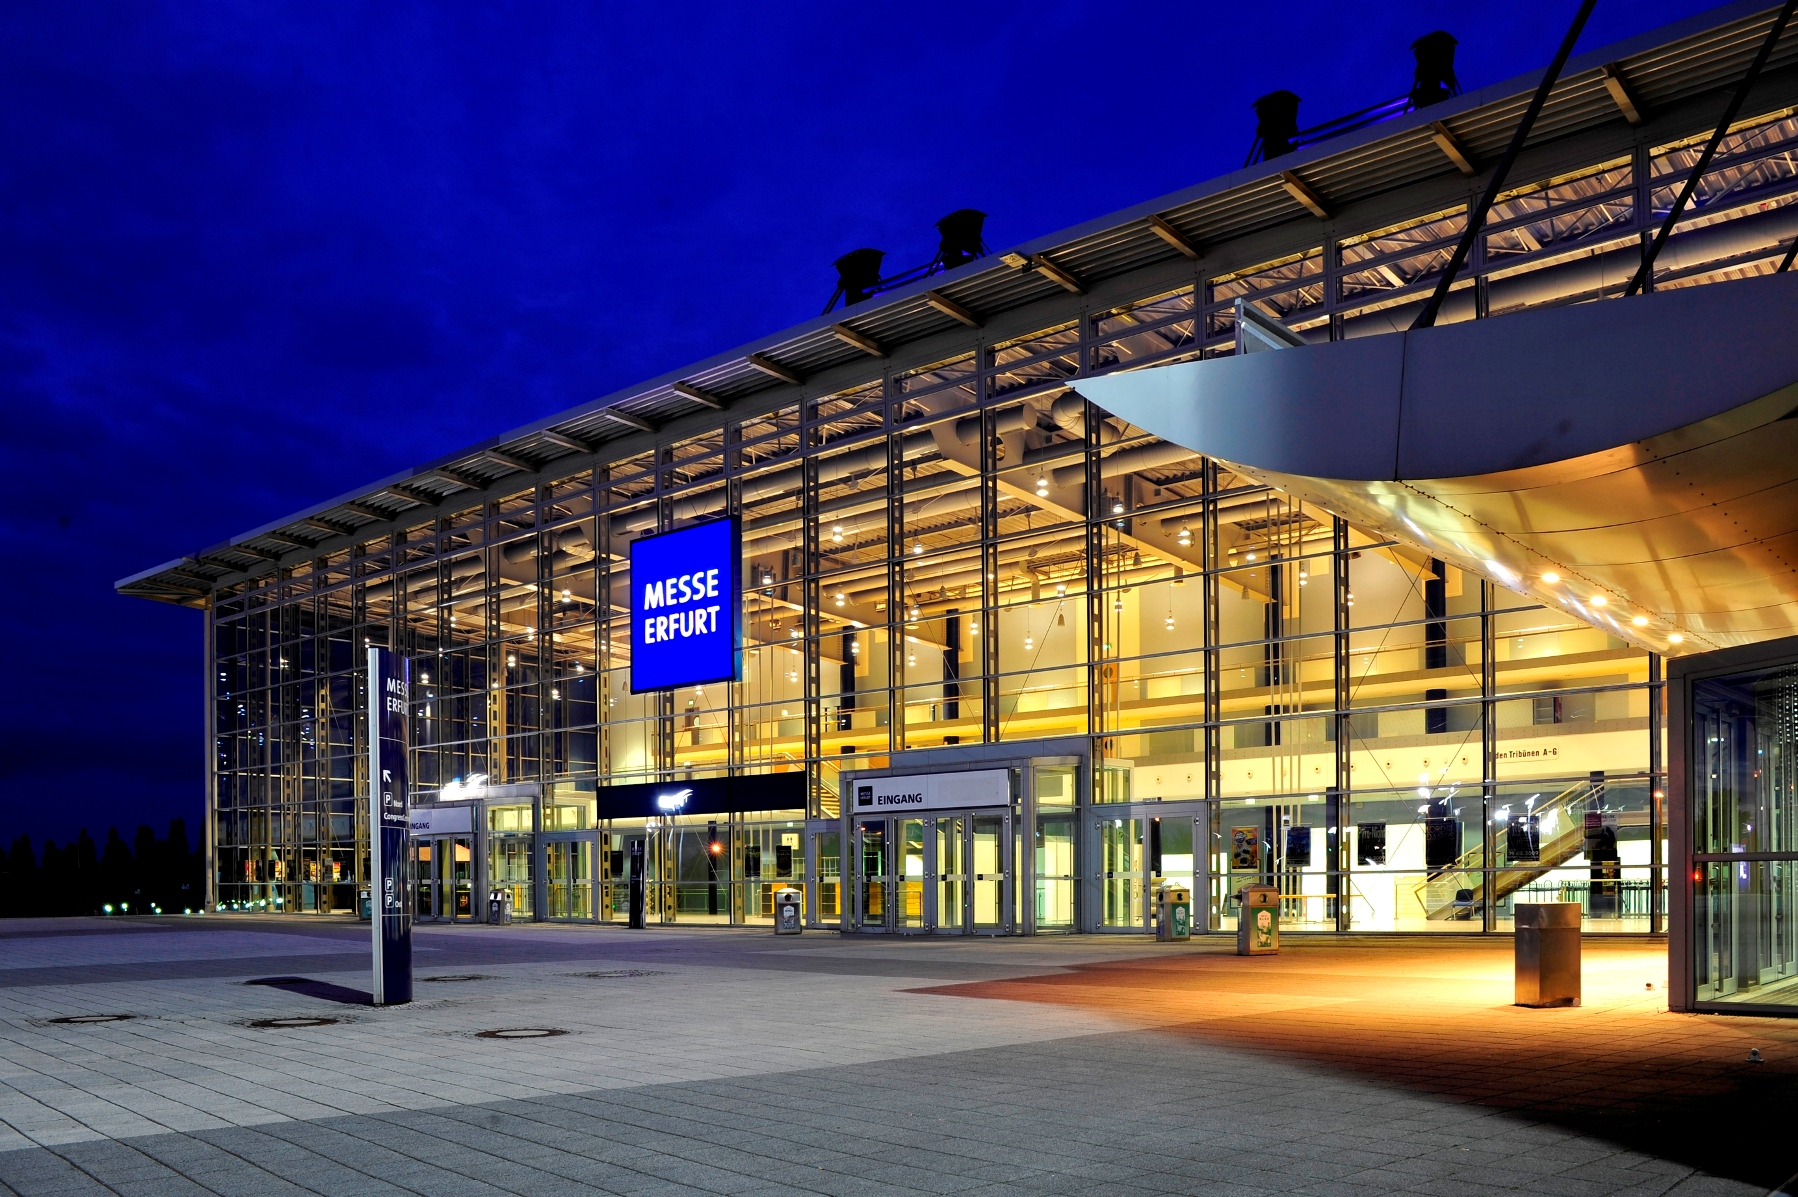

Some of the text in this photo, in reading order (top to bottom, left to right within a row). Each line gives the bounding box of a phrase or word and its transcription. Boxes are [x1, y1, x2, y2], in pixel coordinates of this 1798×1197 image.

[644, 568, 719, 610] MESSE
[644, 605, 720, 644] ERFURT
[386, 677, 409, 697] MESS
[1509, 749, 1540, 758] Tribünen
[877, 793, 923, 805] EINGANG
[410, 822, 430, 830] INGANG
